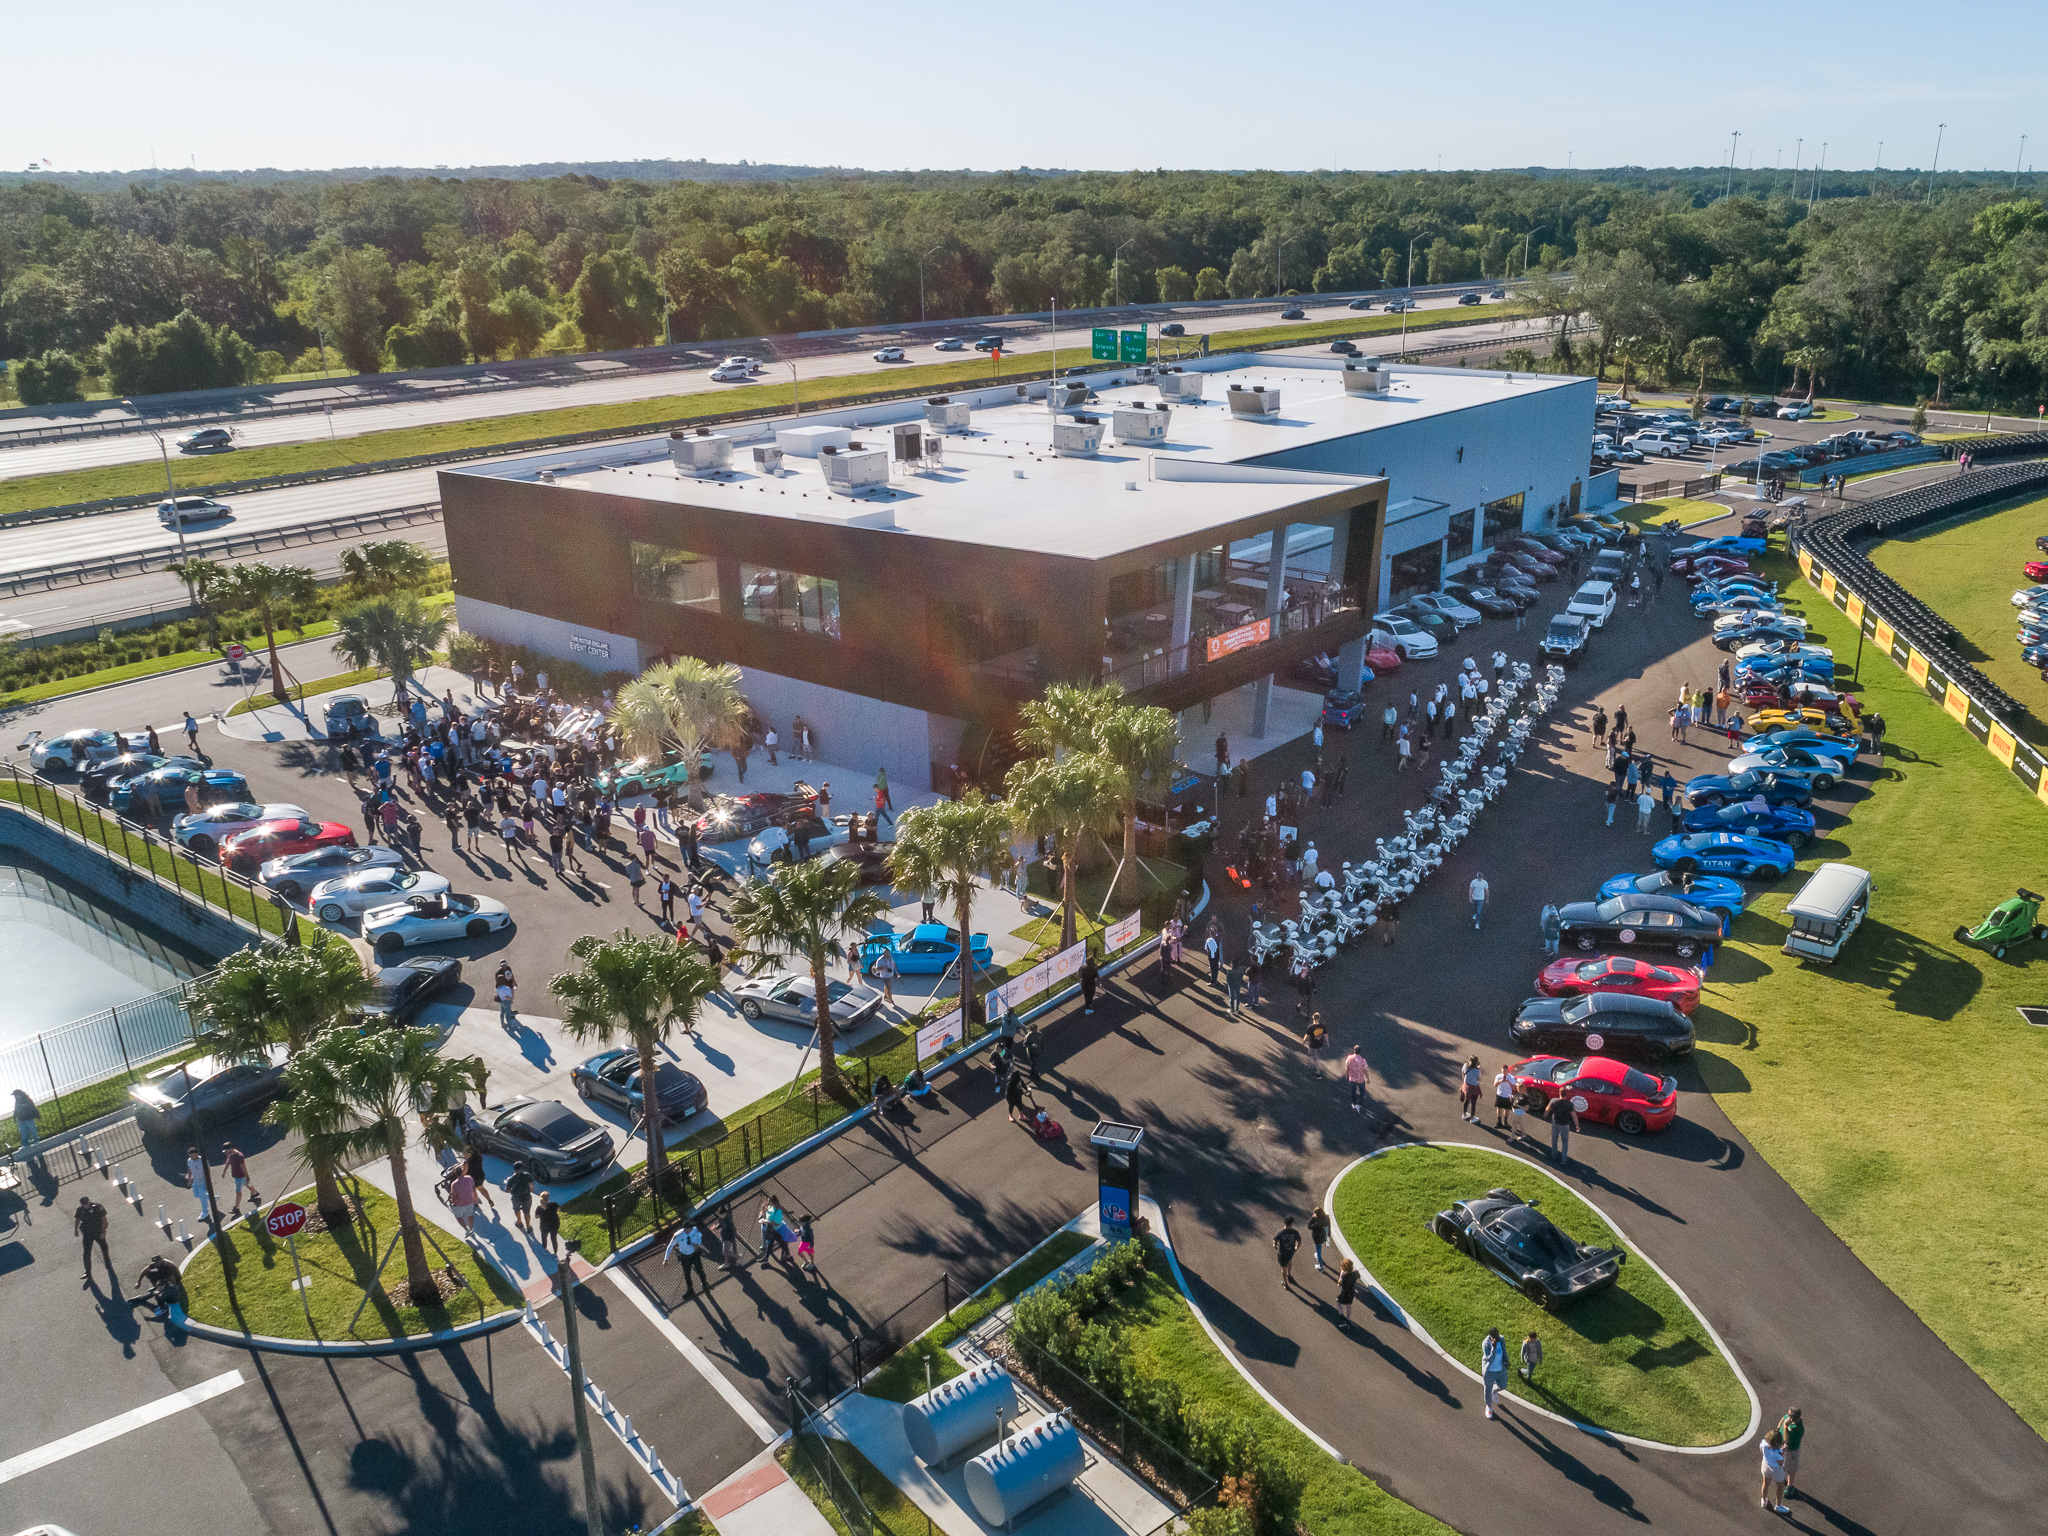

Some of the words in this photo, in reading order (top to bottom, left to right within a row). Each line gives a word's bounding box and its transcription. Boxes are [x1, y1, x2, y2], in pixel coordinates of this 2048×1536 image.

[1095, 343, 1115, 351] Orlando
[1125, 345, 1142, 353] Tampa
[570, 641, 587, 653] EVENT
[588, 646, 609, 658] CENTER
[1948, 692, 1965, 714] PIRELLI
[1993, 732, 2011, 757] PIRELLI
[1171, 777, 1200, 794] ENCLAVE
[269, 1209, 303, 1231] STOP
